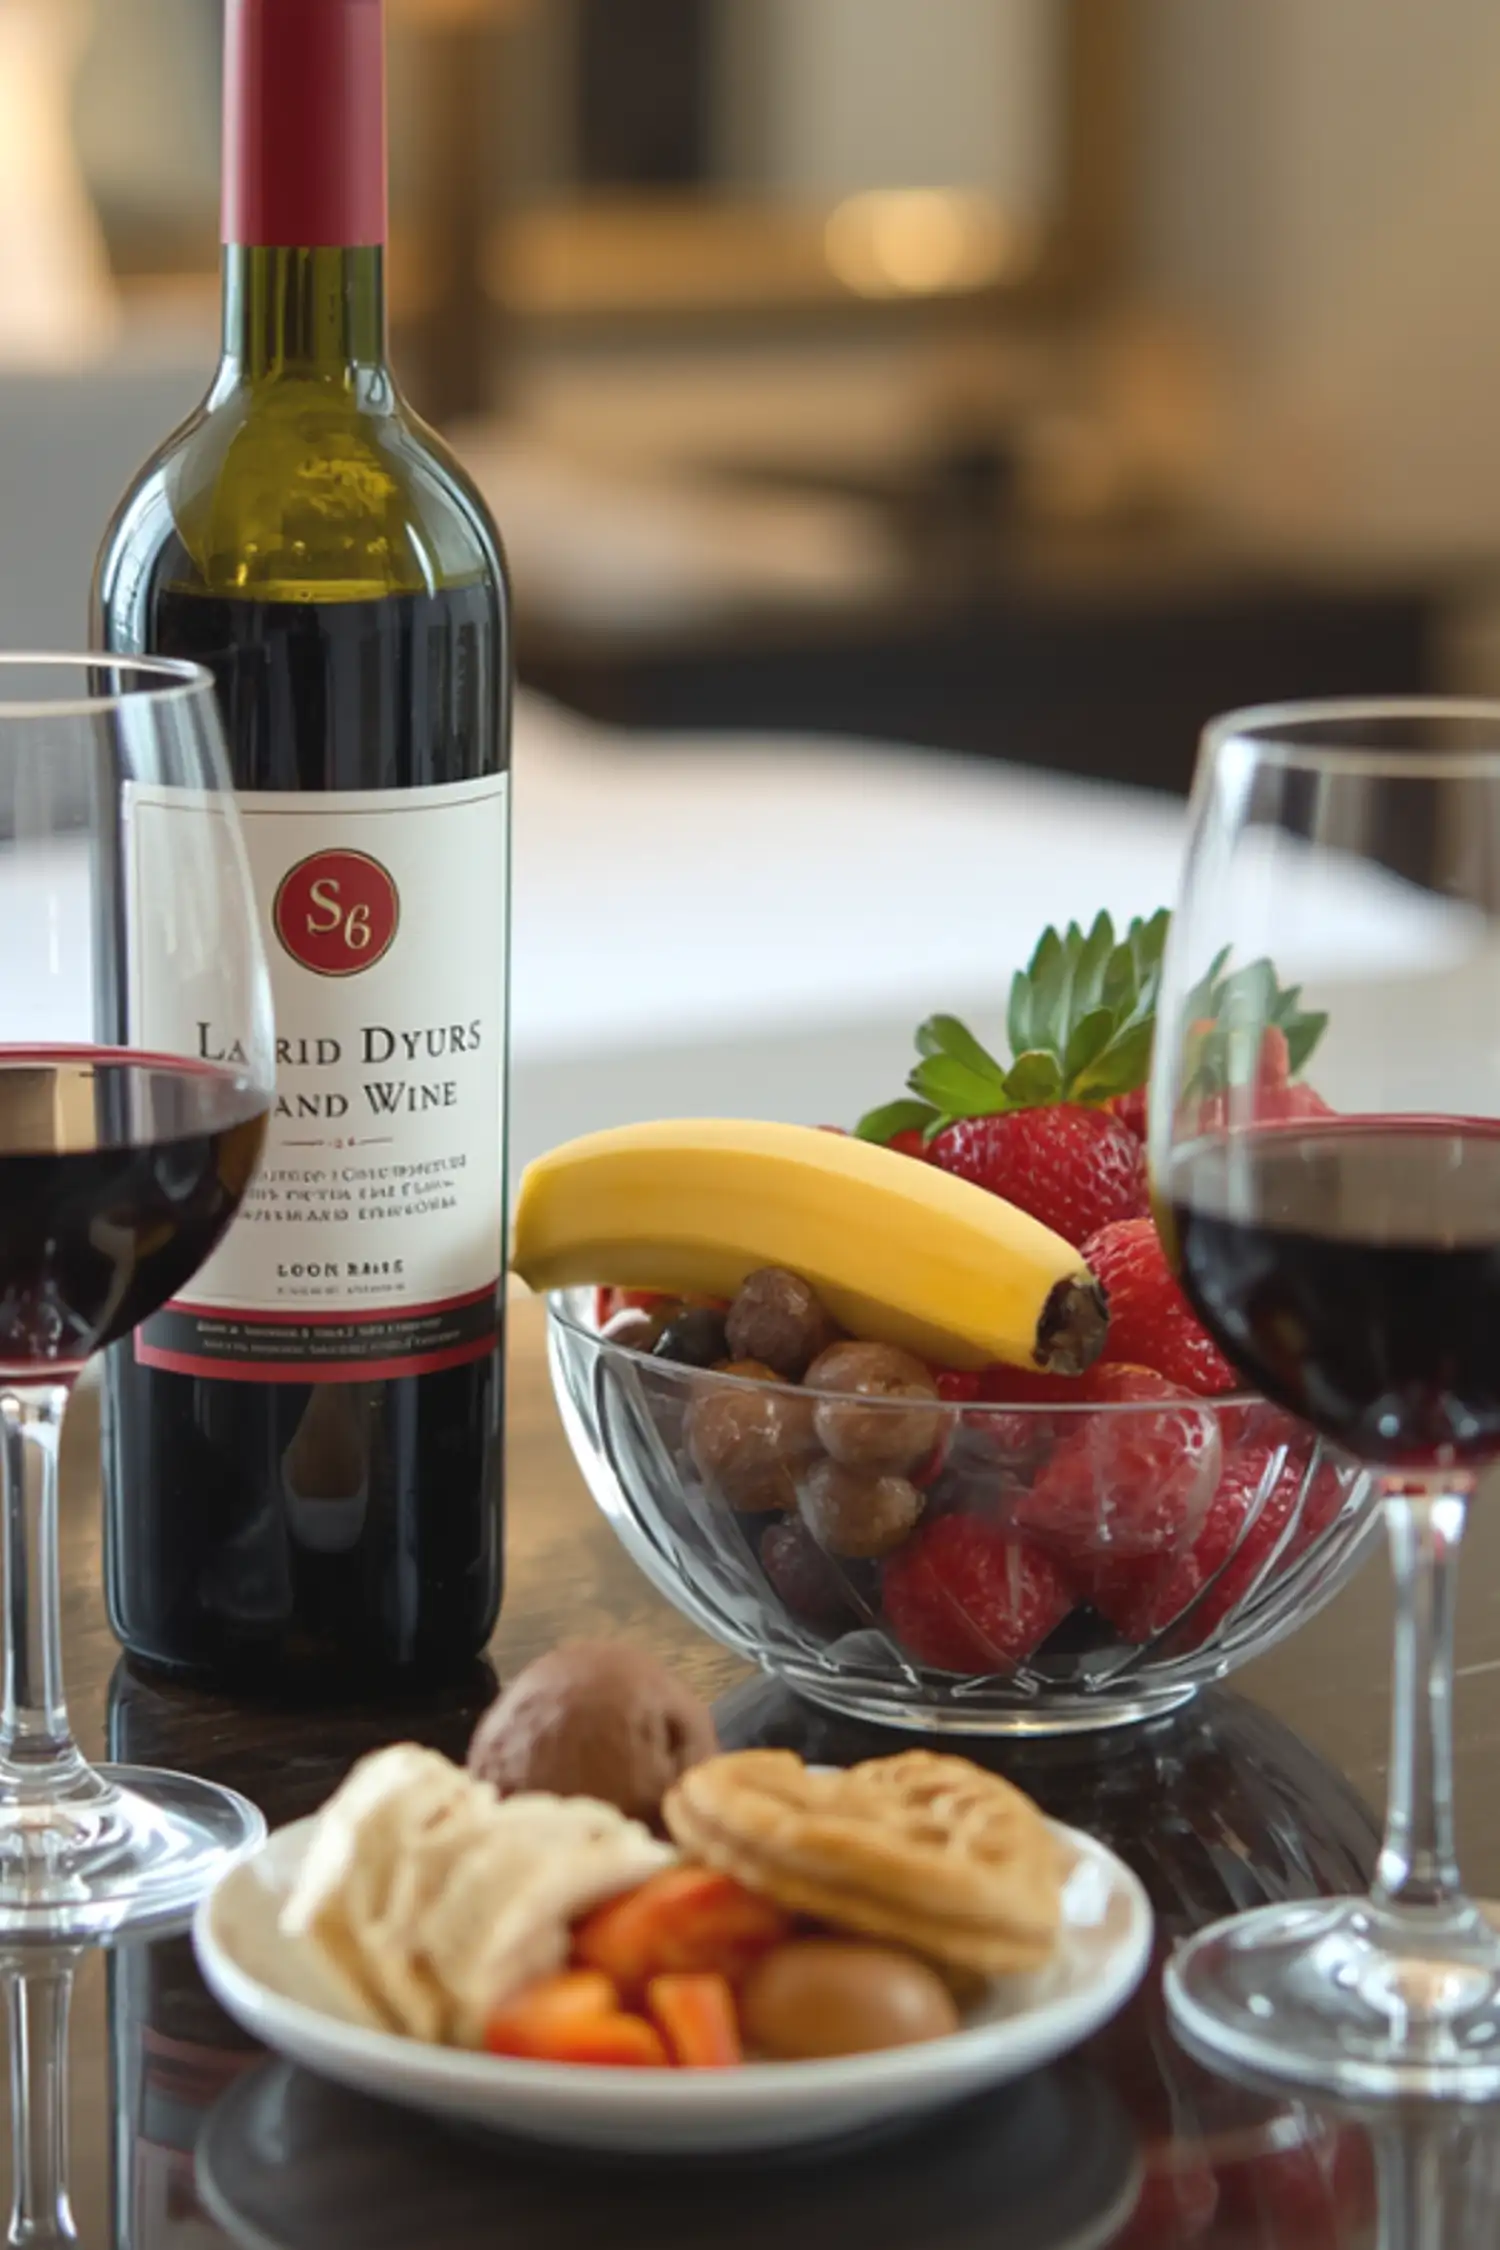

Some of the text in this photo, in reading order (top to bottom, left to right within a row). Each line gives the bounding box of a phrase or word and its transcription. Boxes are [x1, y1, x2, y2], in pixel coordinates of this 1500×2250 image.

[197, 1020, 481, 1065] LARID DYURS
[364, 1081, 457, 1114] WINE
